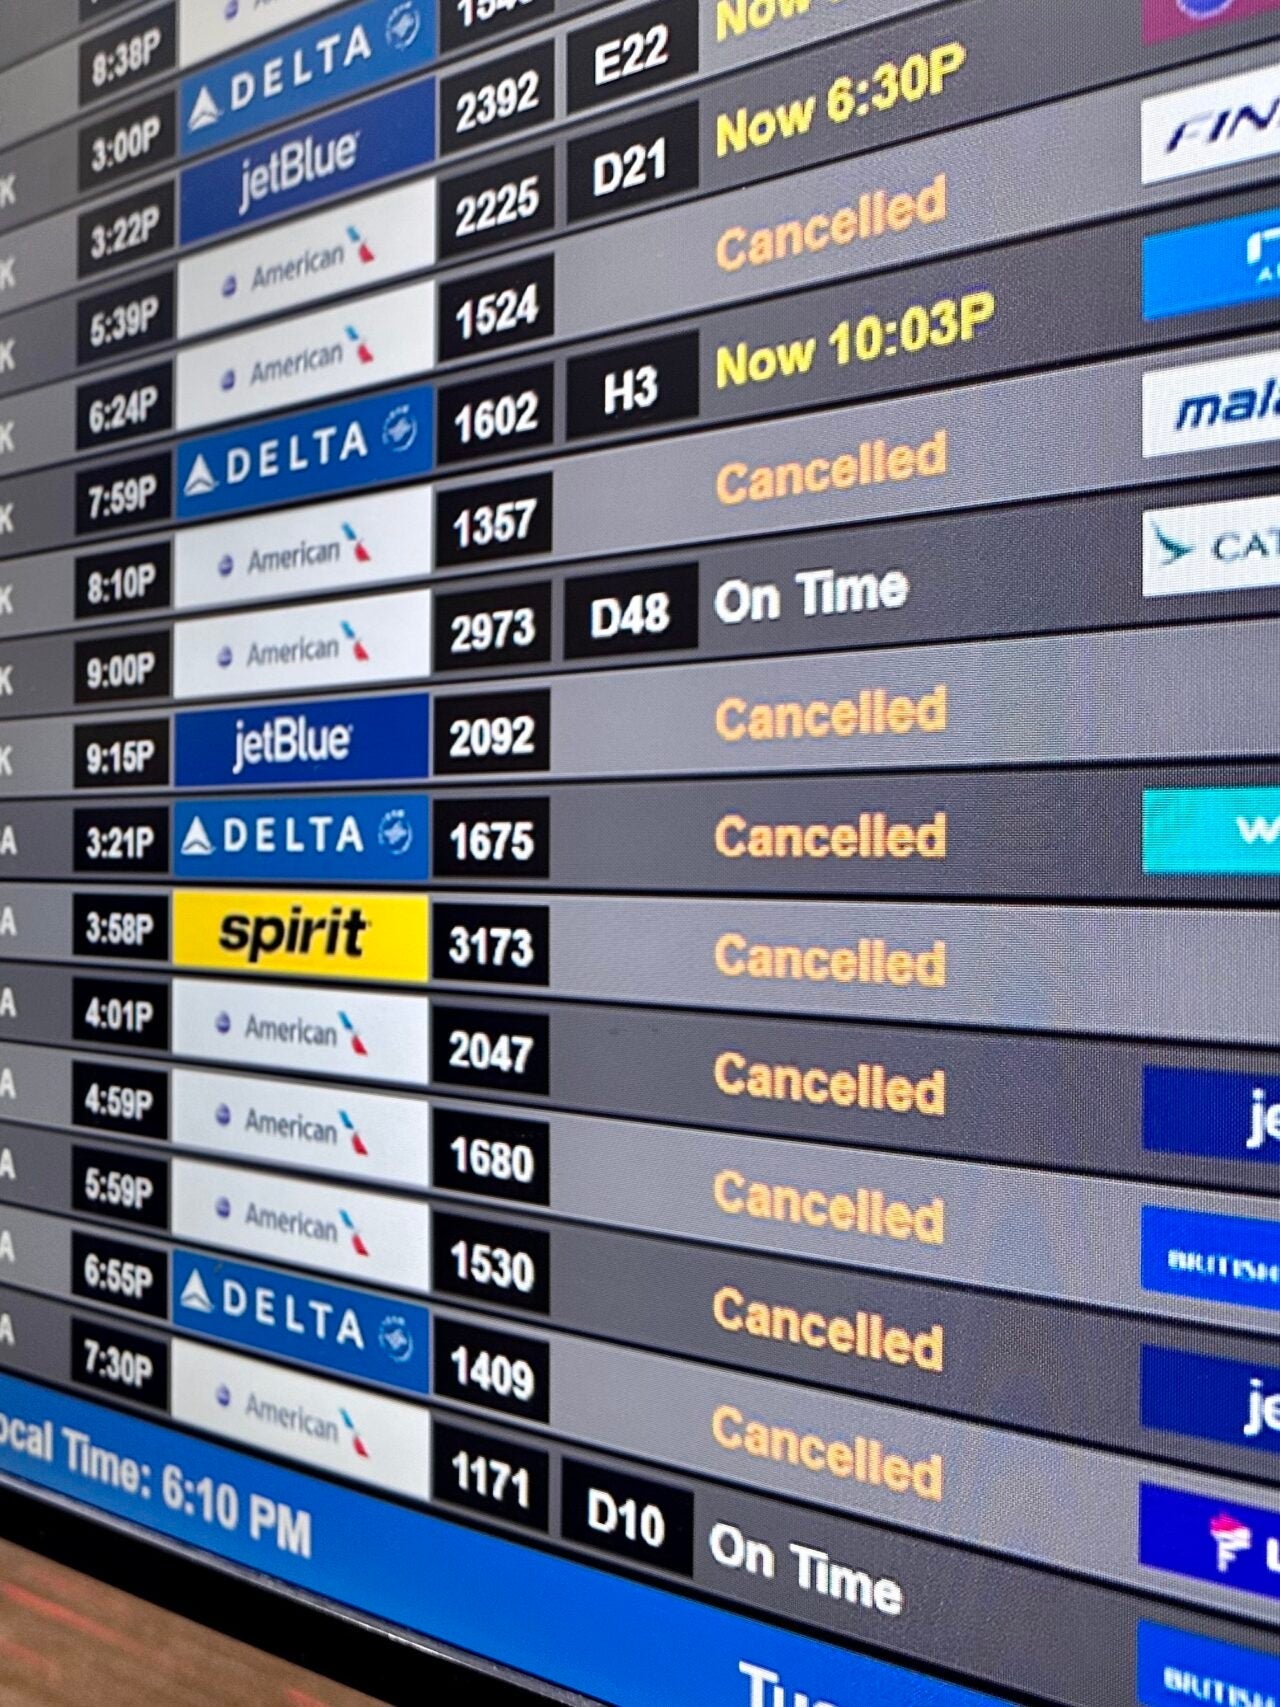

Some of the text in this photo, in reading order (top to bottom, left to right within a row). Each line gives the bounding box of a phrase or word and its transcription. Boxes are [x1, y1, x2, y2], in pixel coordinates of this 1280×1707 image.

[91, 29, 161, 87] 8:38P
[91, 116, 161, 172] 3:00P
[231, 25, 372, 110] DELTA
[91, 205, 160, 259] 3:22P
[238, 133, 357, 215] jetBlue
[456, 70, 539, 133] 2392
[594, 24, 668, 85] E22
[716, 0, 810, 42] Now
[90, 296, 159, 347] 5:39P
[250, 245, 345, 291] American
[455, 175, 539, 237] 2225
[593, 137, 665, 197] D21
[716, 100, 814, 156] Now
[827, 41, 967, 123] 6:30P
[89, 386, 158, 433] 6:24P
[250, 343, 343, 385] American
[456, 283, 539, 339] 1524
[716, 174, 948, 272] Cancelled
[88, 474, 157, 519] 7:59P
[227, 421, 368, 484] DELTA
[454, 390, 538, 443] 1602
[604, 365, 658, 415] H3
[716, 341, 816, 388] Now
[828, 291, 997, 364] 10:03P
[87, 563, 156, 604] 8:10P
[247, 539, 340, 574] American
[453, 498, 537, 547] 1357
[716, 430, 949, 506] Cancelled
[87, 651, 155, 689] 9:00P
[246, 635, 339, 667] American
[451, 607, 536, 653] 2973
[591, 592, 670, 638] D48
[714, 579, 781, 623] On
[794, 569, 909, 615] Time
[86, 739, 155, 774] 9:15P
[232, 716, 353, 774] jetBlue
[449, 715, 535, 757] 2092
[714, 685, 949, 742] Cancelled
[86, 826, 154, 859] 3:21P
[224, 815, 364, 852] DELTA
[450, 821, 534, 861] 1675
[714, 812, 948, 860] Cancelled
[86, 911, 154, 945] 3:58P
[218, 907, 366, 963] spirit
[448, 926, 534, 967] 3173
[713, 933, 948, 989] Cancelled
[85, 997, 153, 1032] 4:01P
[244, 1013, 338, 1046] American
[449, 1030, 534, 1073] 2047
[713, 1051, 946, 1115] Cancelled
[84, 1083, 153, 1120] 4:59P
[244, 1107, 338, 1145] American
[450, 1136, 534, 1183] 1680
[712, 1170, 945, 1245] Cancelled
[85, 1167, 153, 1209] 5:59P
[244, 1202, 338, 1244] American
[451, 1240, 535, 1292] 1530
[712, 1287, 945, 1371] Cancelled
[84, 1253, 153, 1298] 6:55P
[223, 1279, 364, 1349] DELTA
[451, 1345, 535, 1401] 1409
[712, 1405, 944, 1501] Cancelled
[61, 1427, 151, 1495] Time:
[161, 1464, 239, 1532] 6:10
[250, 1494, 312, 1560] PM
[84, 1339, 153, 1387] 7:30P
[245, 1392, 339, 1444] American
[452, 1451, 529, 1508] 1171
[588, 1488, 665, 1547] D10
[709, 1522, 775, 1578] On
[789, 1543, 903, 1615] Time
